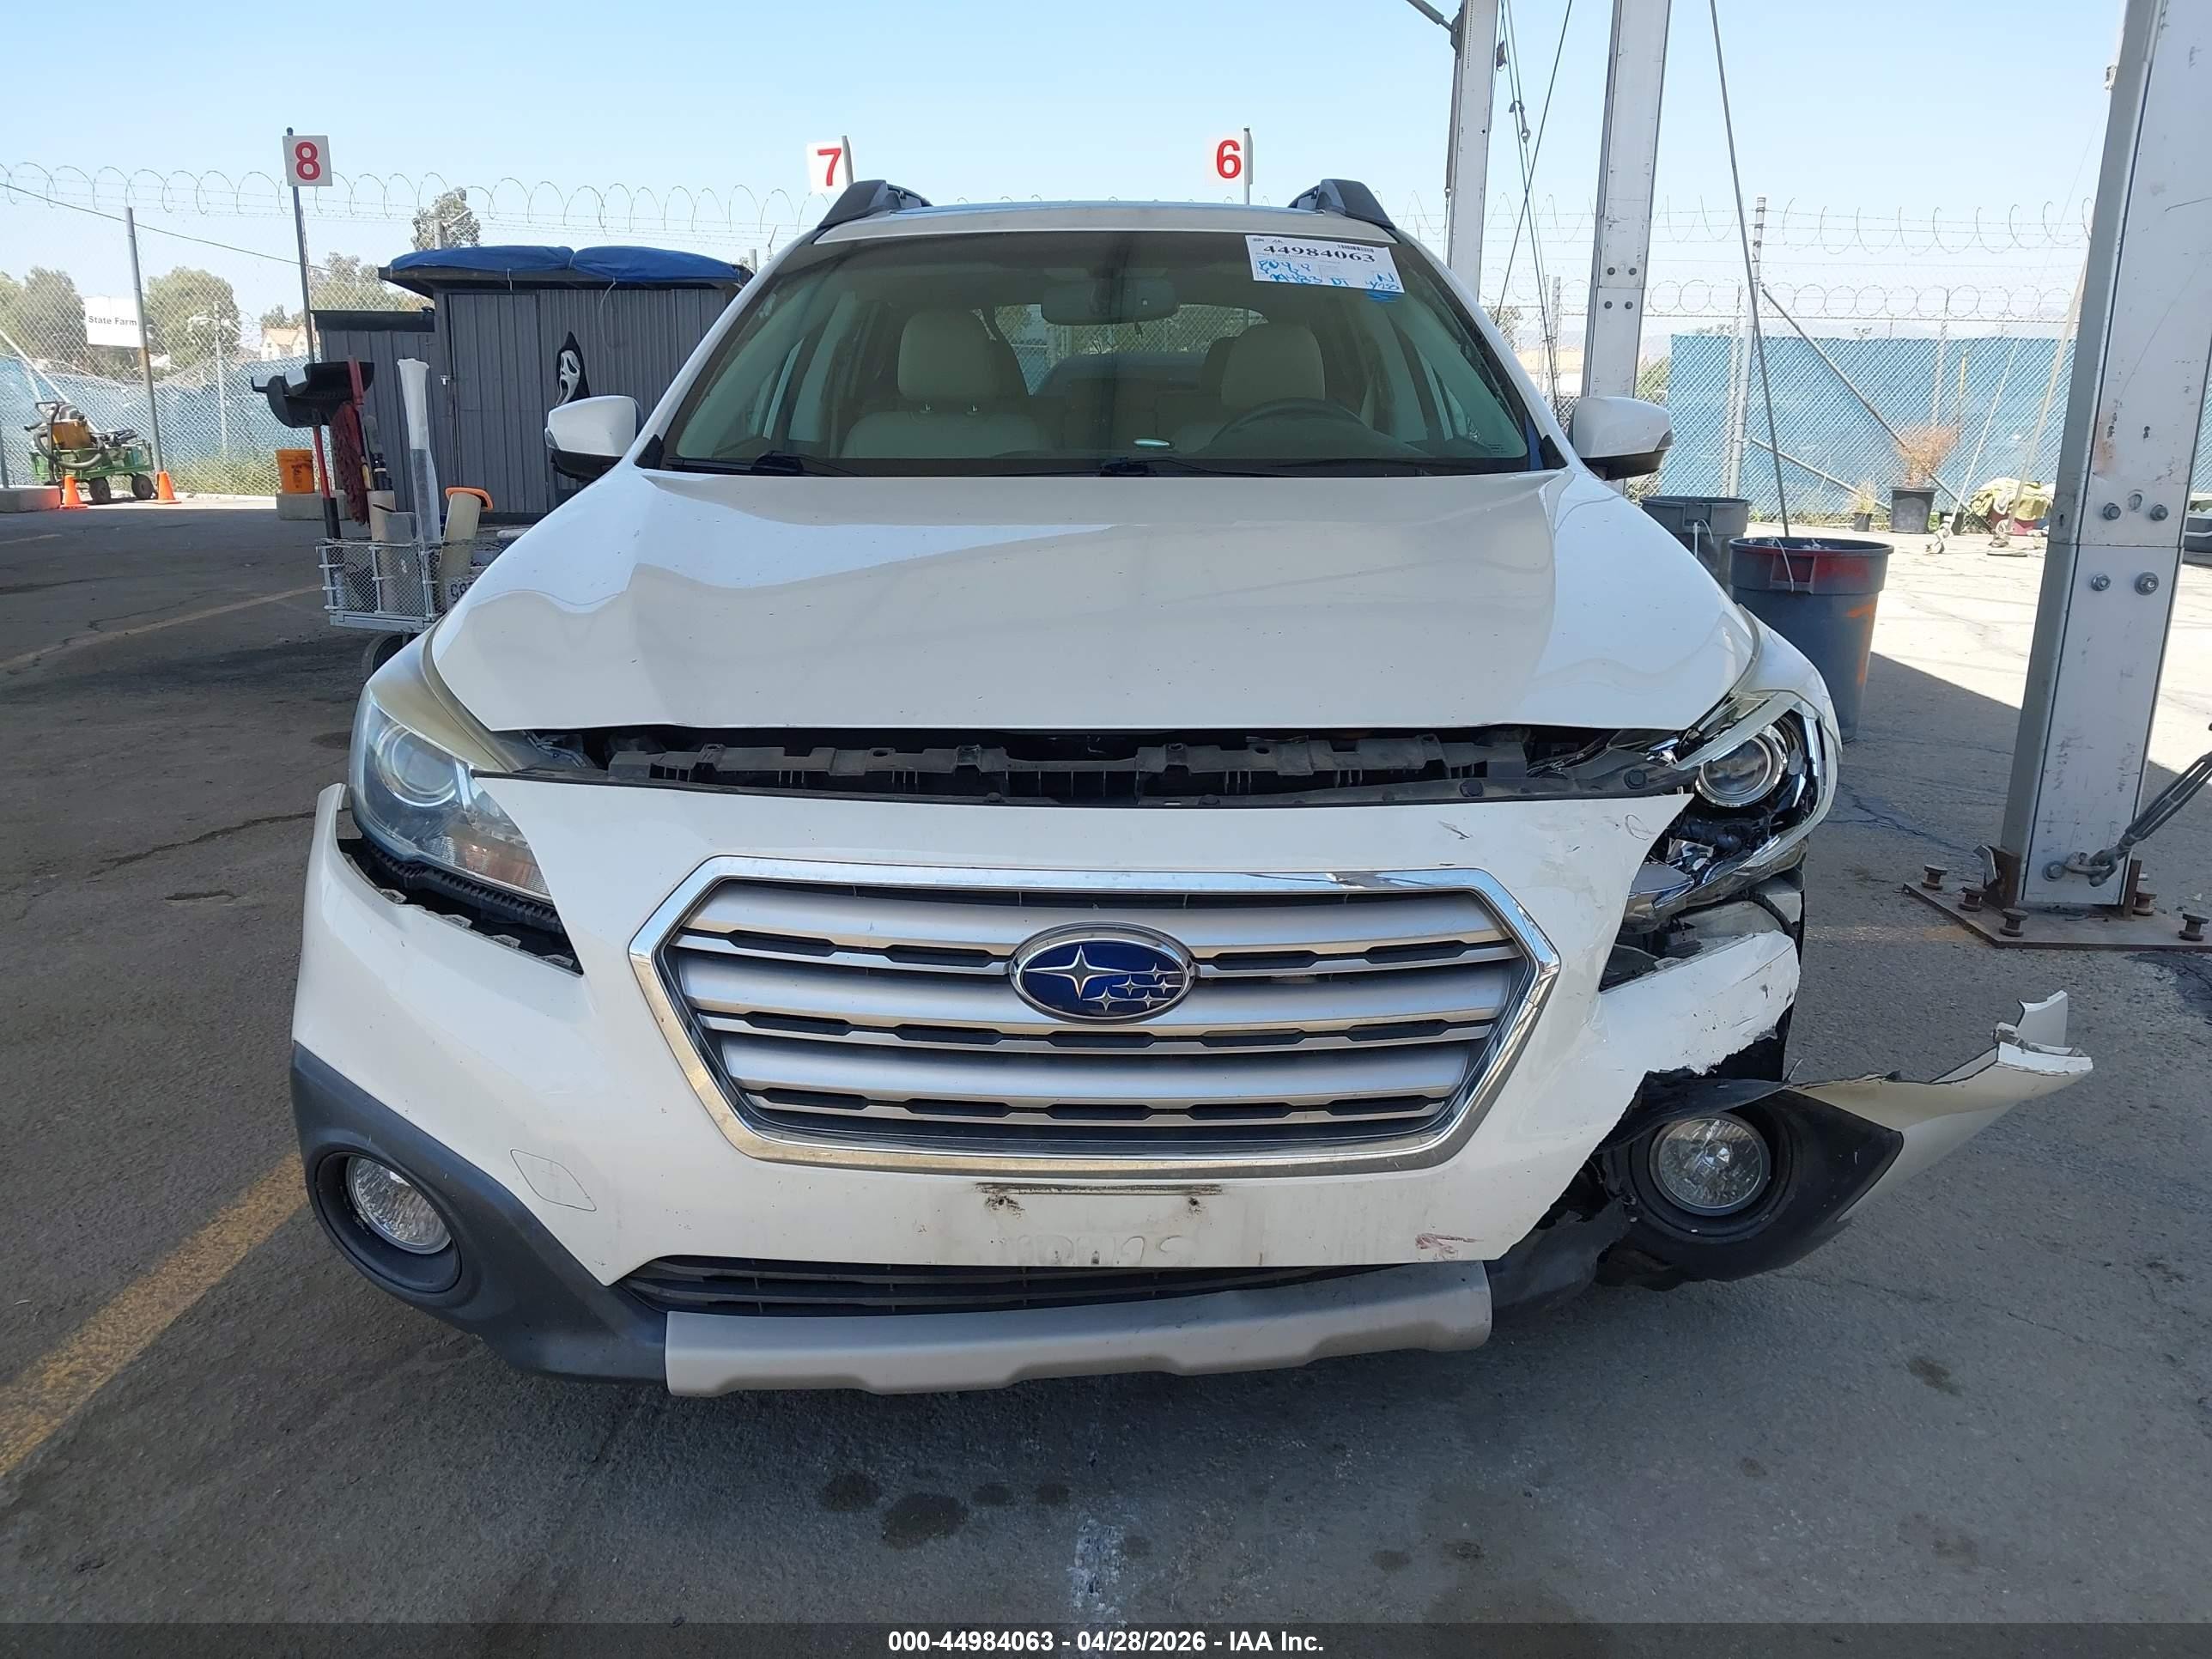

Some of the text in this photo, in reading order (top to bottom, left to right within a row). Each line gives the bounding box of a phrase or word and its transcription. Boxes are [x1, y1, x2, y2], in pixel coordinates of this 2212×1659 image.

[295, 142, 320, 180] 8
[817, 148, 842, 186] 7
[1217, 140, 1241, 179] 6
[1263, 245, 1376, 263] 44984063
[88, 315, 137, 326] State Farm
